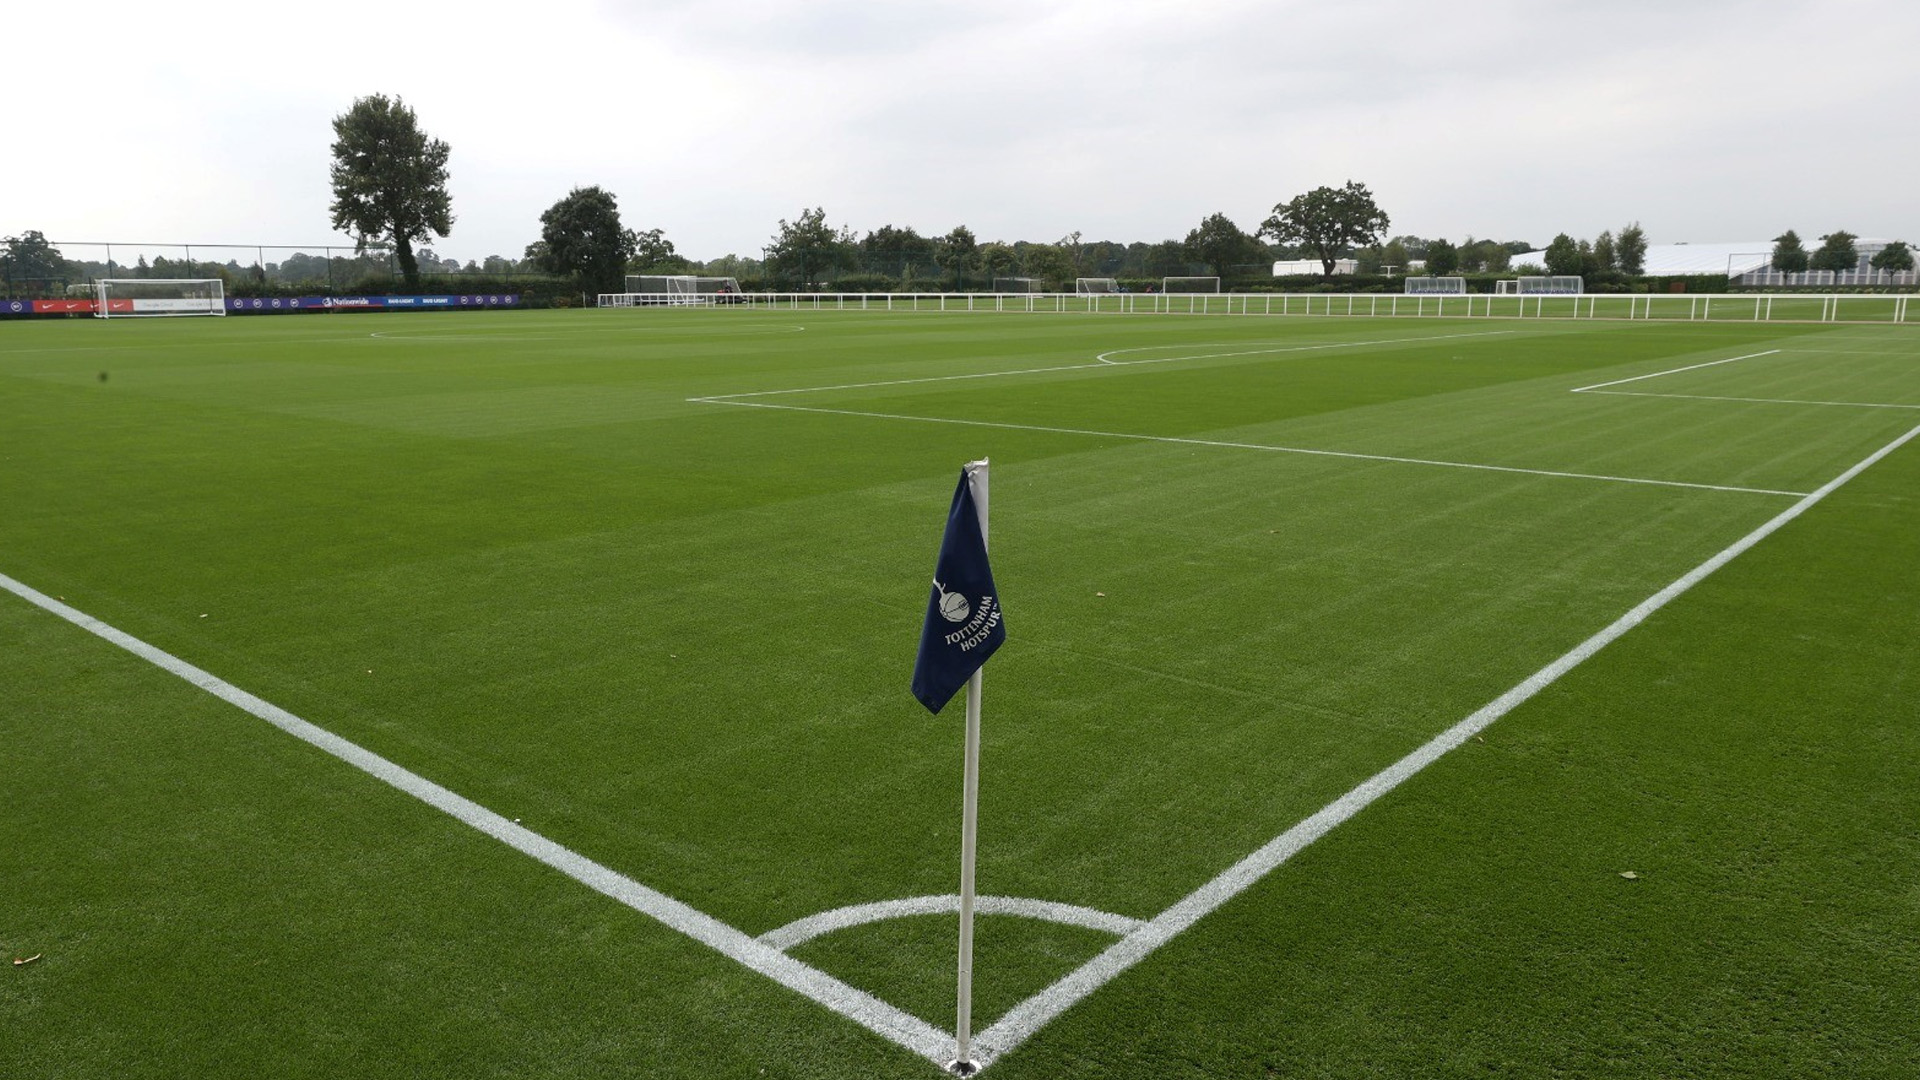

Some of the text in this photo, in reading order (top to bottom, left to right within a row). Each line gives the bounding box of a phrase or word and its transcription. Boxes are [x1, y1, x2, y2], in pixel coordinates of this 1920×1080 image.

[333, 297, 369, 306] Nationwide
[945, 596, 993, 645] TOTTENHAM
[959, 611, 1001, 652] HOTSPUR
